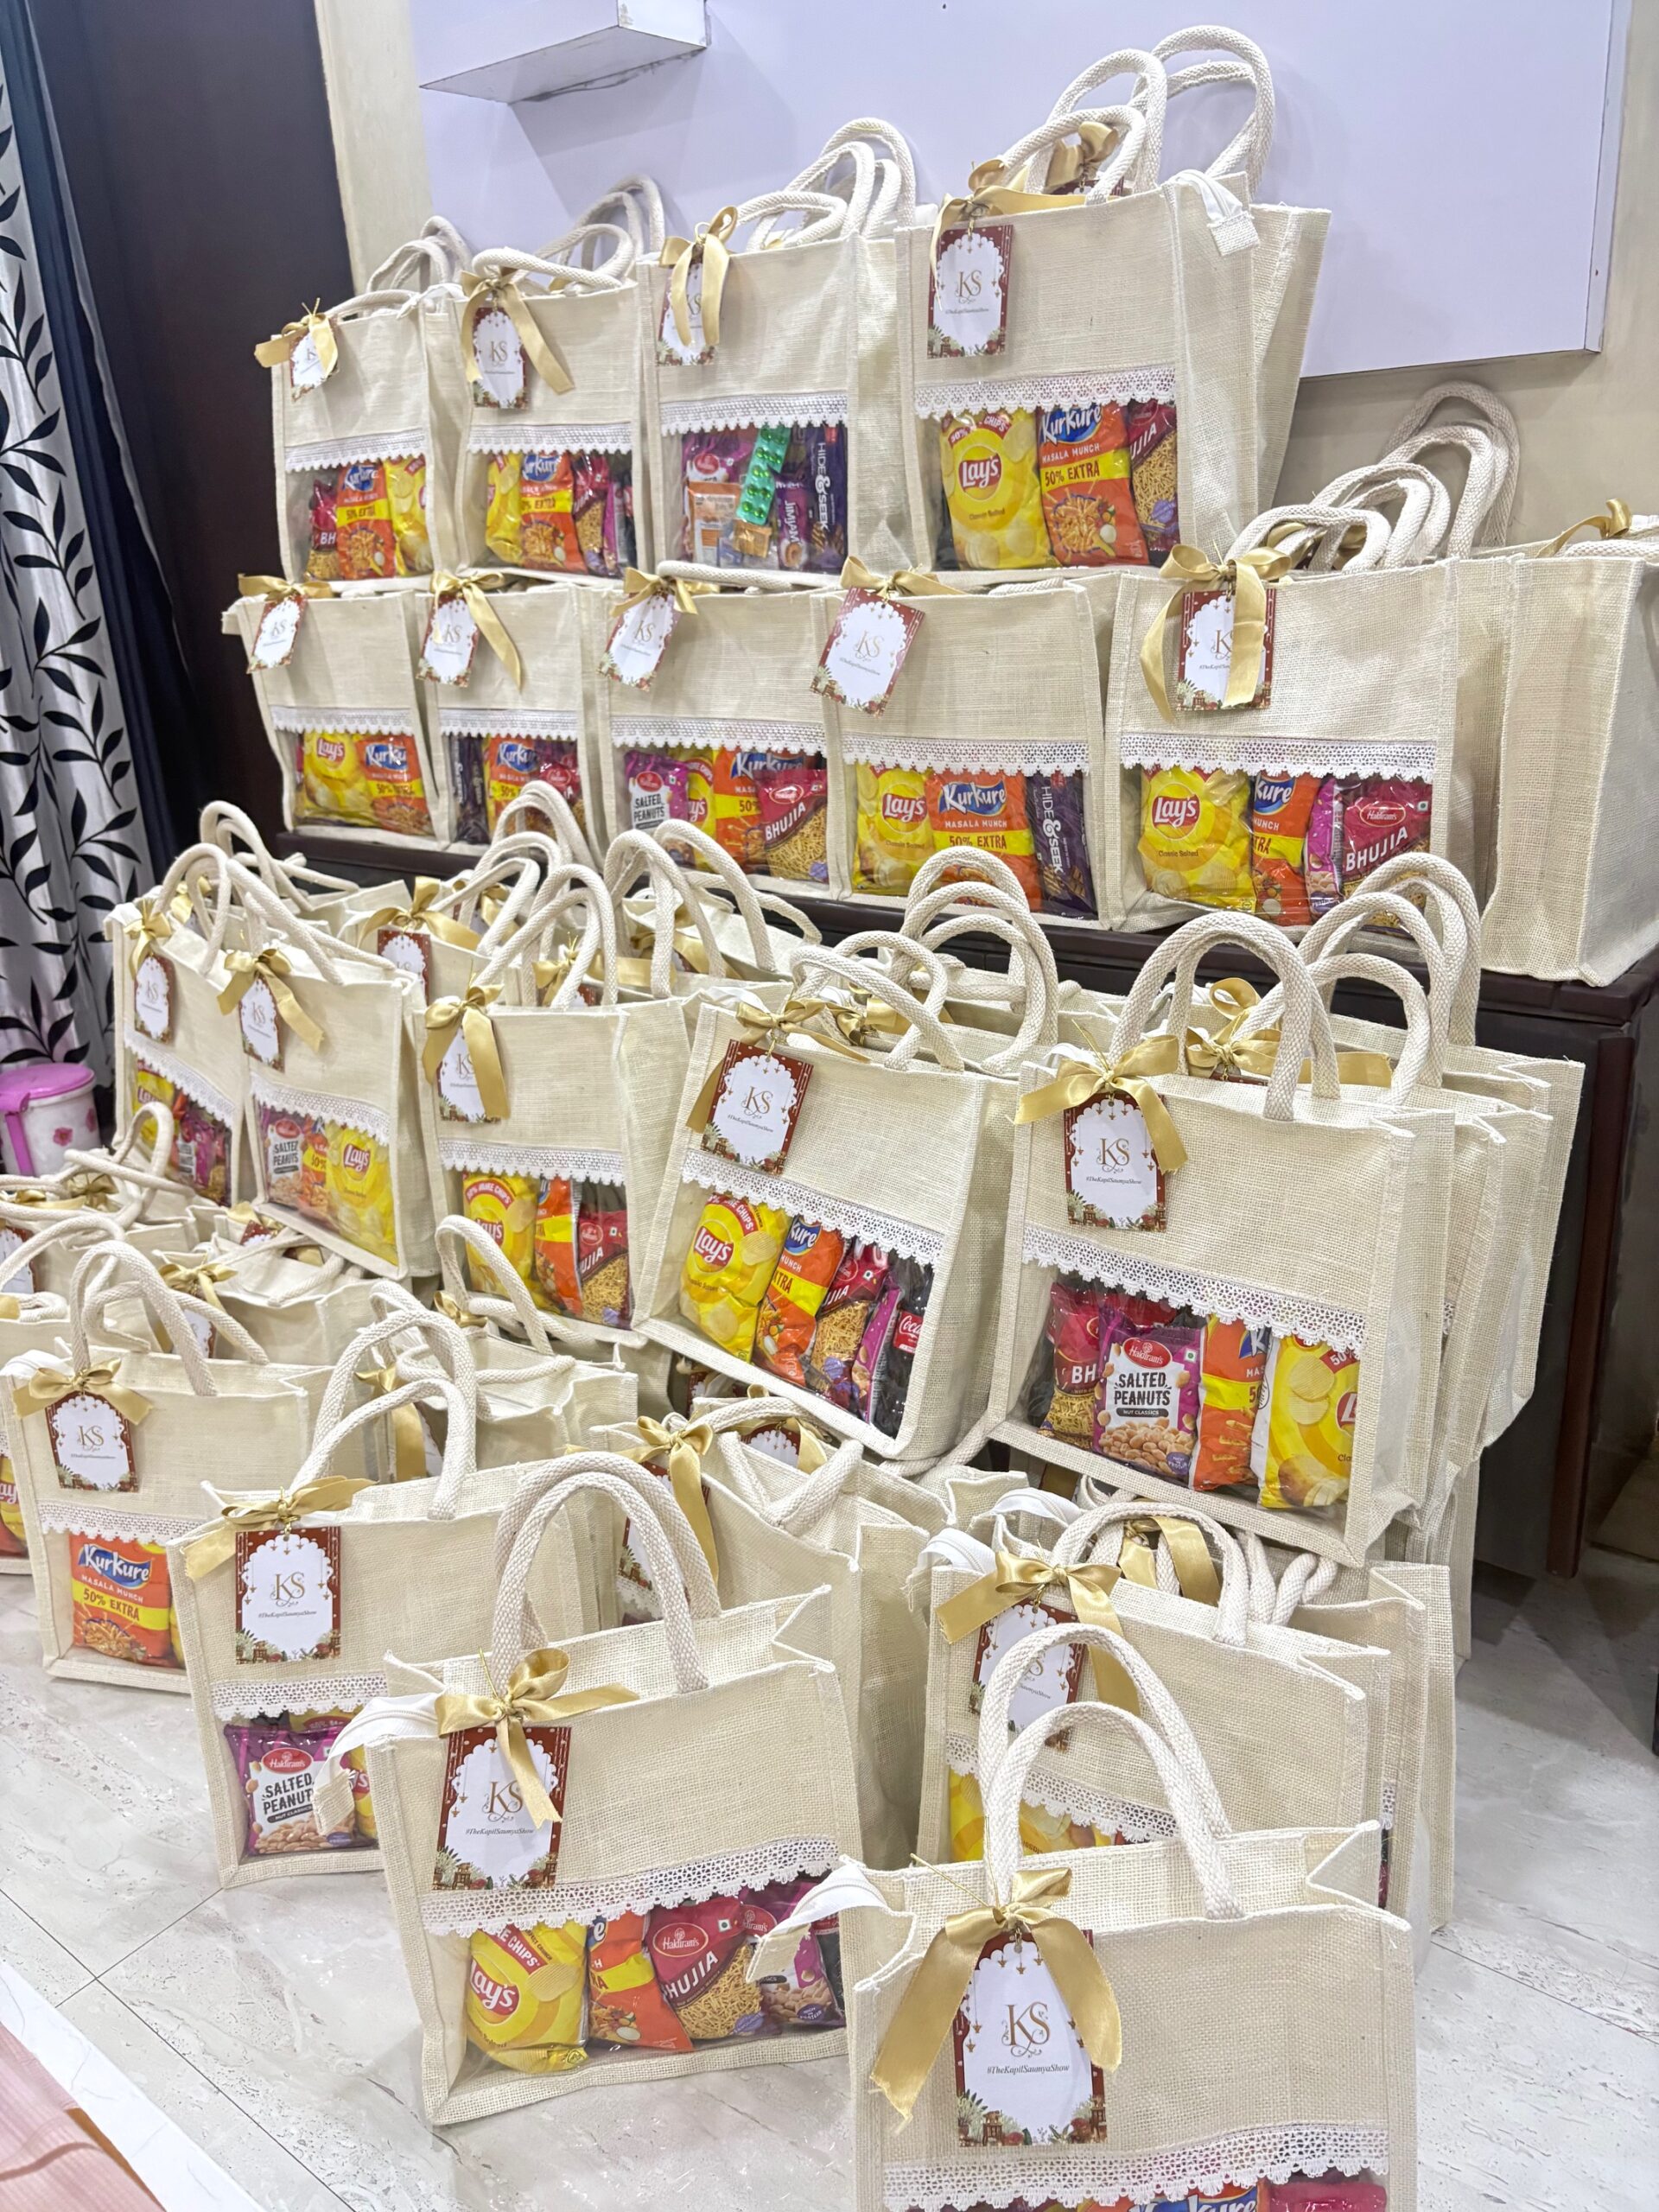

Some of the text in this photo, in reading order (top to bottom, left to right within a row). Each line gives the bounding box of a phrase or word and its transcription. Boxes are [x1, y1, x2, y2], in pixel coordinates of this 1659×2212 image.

[1041, 407, 1102, 444] Kurkure
[1072, 442, 1100, 457] MUNCH
[963, 456, 1000, 489] Lay's
[1045, 461, 1100, 486] 50% EXTRA
[886, 794, 925, 822] Lay's
[942, 780, 1007, 813] Kurkure
[766, 802, 806, 841] BHUJIA
[1154, 796, 1198, 827] Lay's
[977, 836, 1007, 849] EXTRA
[1345, 826, 1408, 872] BHUJIA
[745, 1086, 773, 1114] KS
[345, 1144, 370, 1172] Lay's
[1101, 1138, 1129, 1166] KS
[695, 1227, 732, 1263] Lay's
[1128, 1345, 1164, 1364] Haldiram's
[1119, 1371, 1166, 1389] SALTED
[1114, 1389, 1171, 1407] PEANUTS
[79, 1425, 104, 1446] KS
[84, 1543, 149, 1581] Kurkure
[276, 1571, 305, 1599] KS
[83, 1588, 140, 1622] 50% EXTRA
[264, 1773, 312, 1799] SALTED
[490, 1780, 524, 1814] KS
[263, 1788, 315, 1815] PEANUT
[508, 1935, 538, 1967] CHIPS
[662, 1936, 700, 1950] Haldiram's
[1004, 2001, 1051, 2046] KS
[987, 2063, 1070, 2075] #TheKapilSaumyaShow
